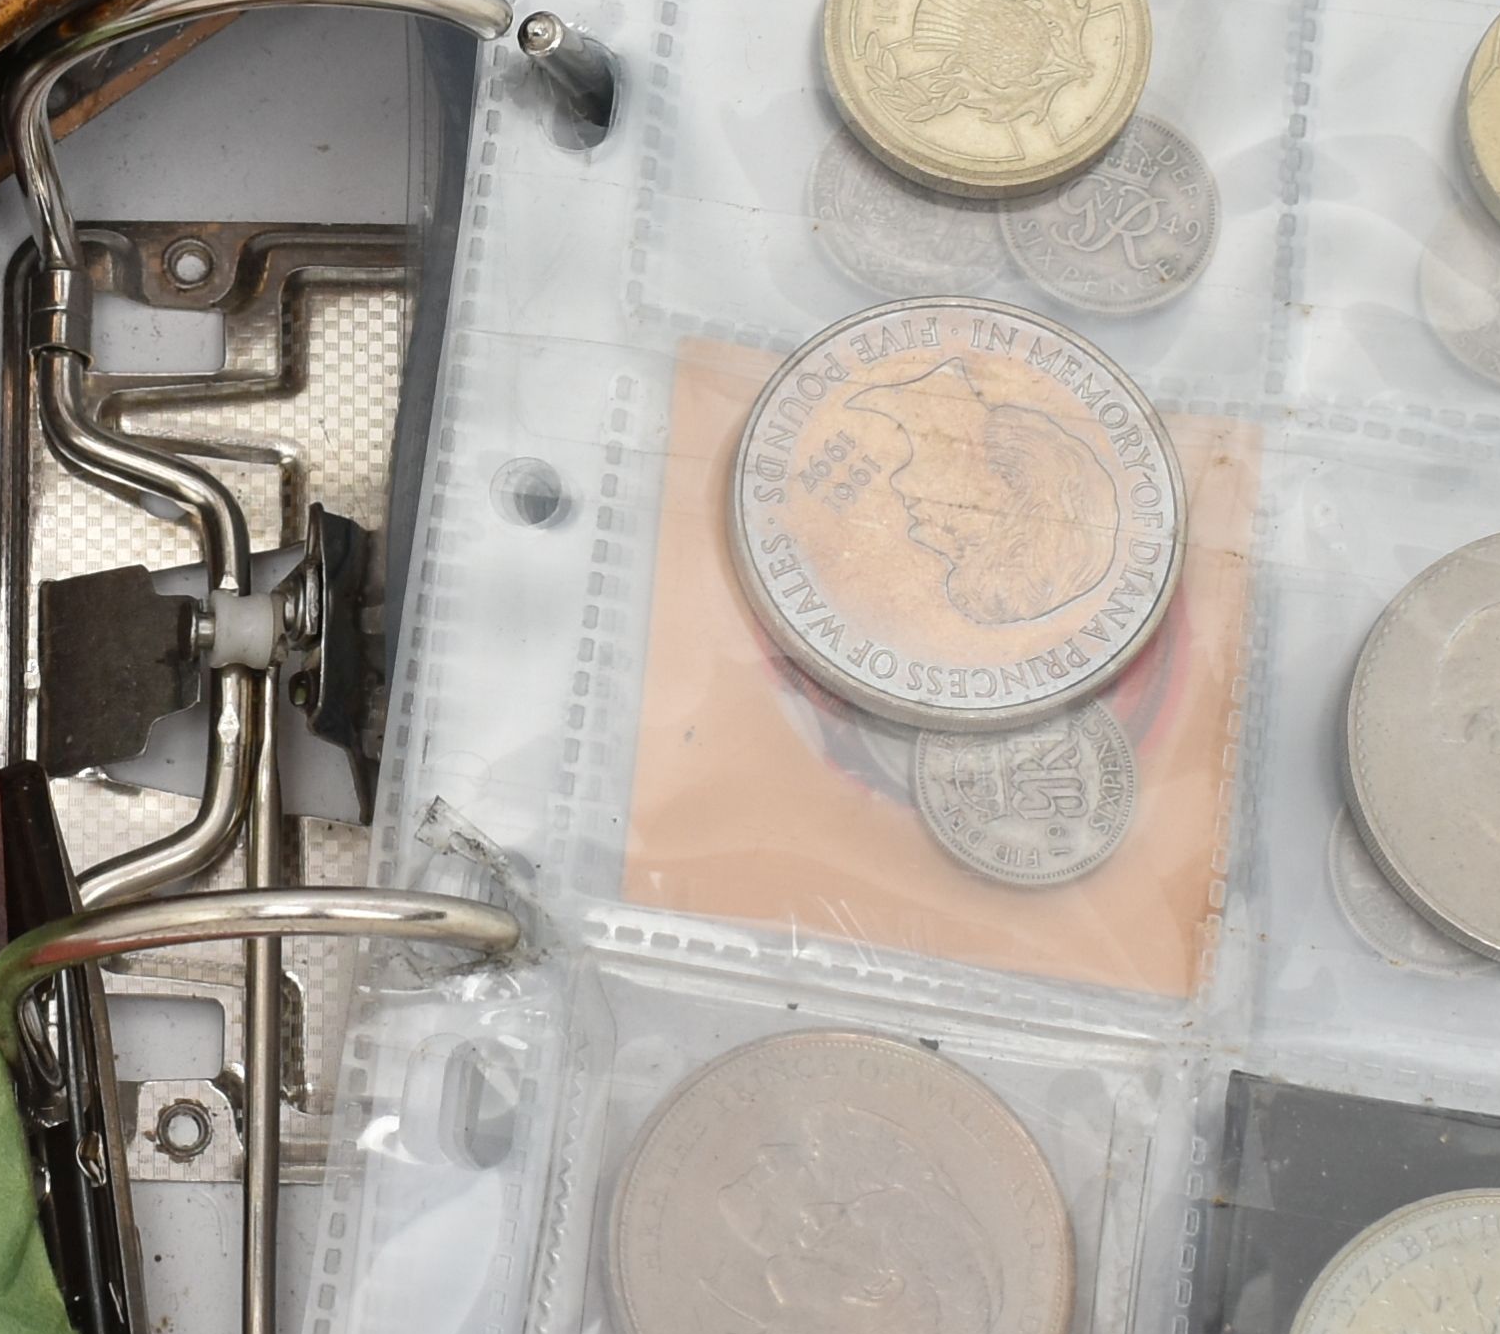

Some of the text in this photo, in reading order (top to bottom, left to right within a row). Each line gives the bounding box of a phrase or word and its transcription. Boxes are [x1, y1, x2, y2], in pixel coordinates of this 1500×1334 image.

[856, 316, 940, 366] FIVE
[971, 319, 1021, 358] IN
[752, 353, 853, 506] POUNDS
[1025, 336, 1154, 482] MEMORY
[762, 531, 847, 651] WALES
[1079, 540, 1163, 643] DIANA
[906, 641, 1090, 700] PRINCESS
